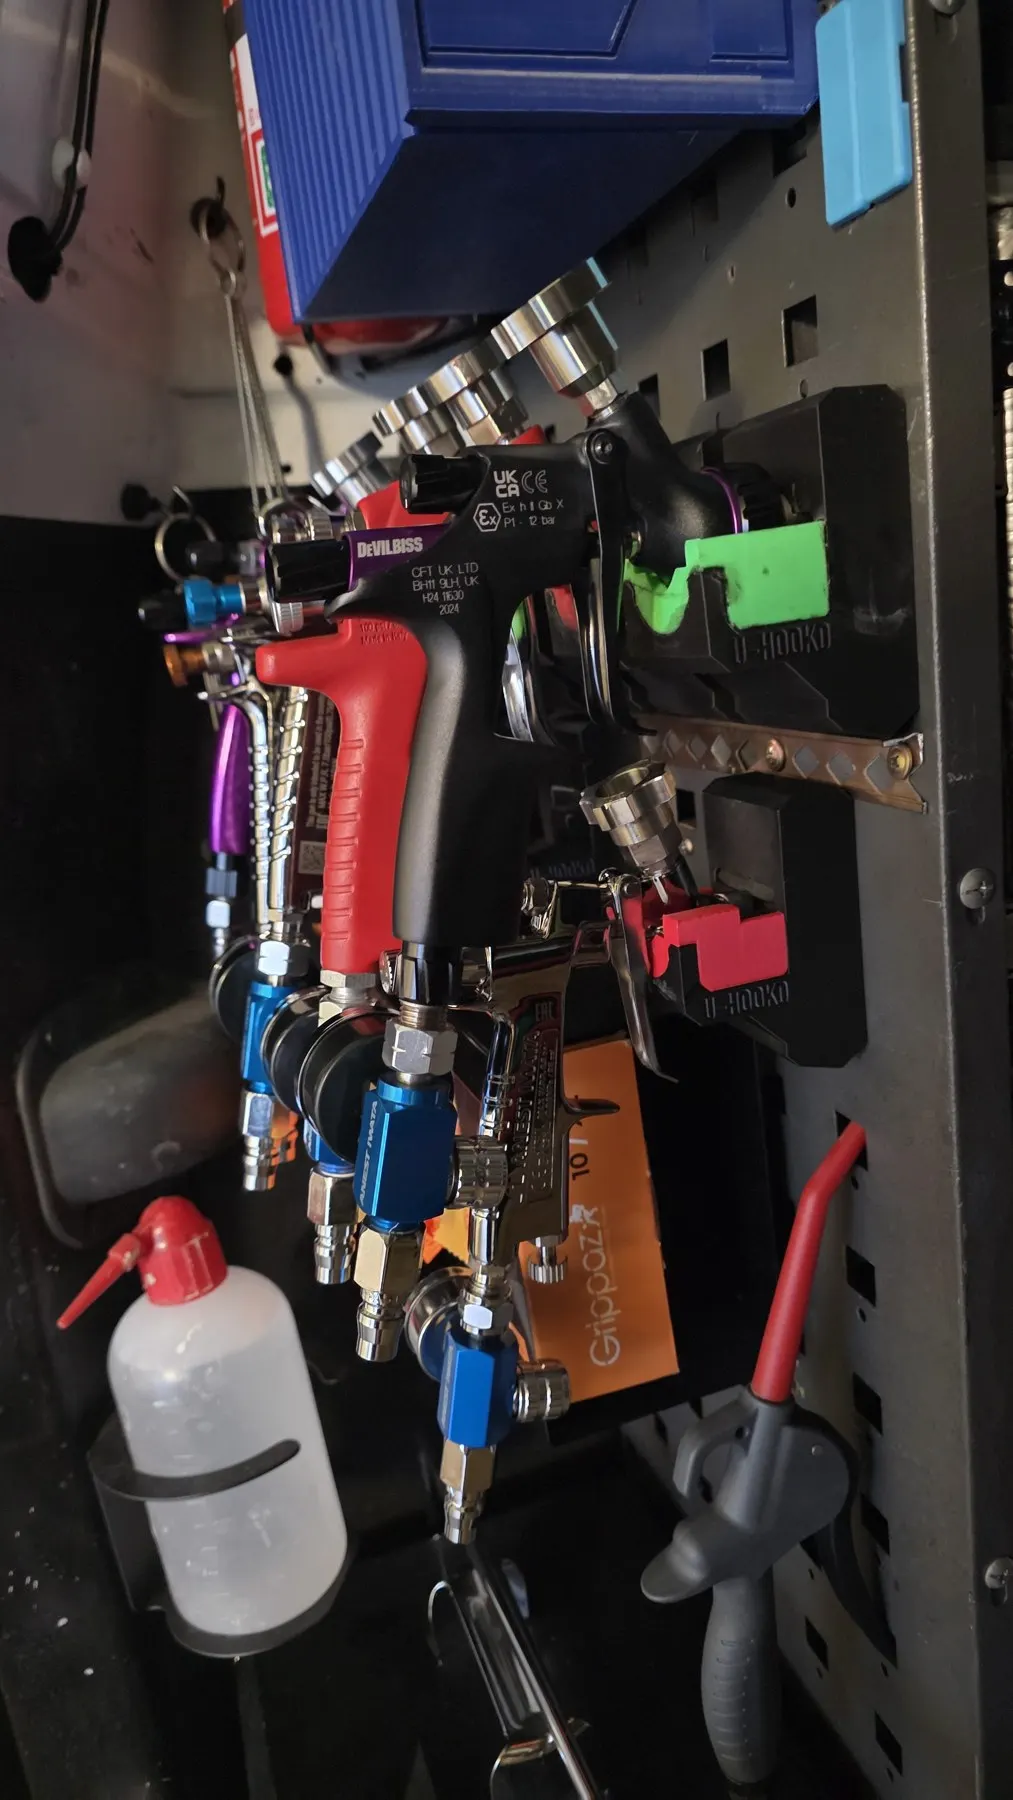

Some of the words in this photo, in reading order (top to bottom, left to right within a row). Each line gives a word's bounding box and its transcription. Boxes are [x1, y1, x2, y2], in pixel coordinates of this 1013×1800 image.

[493, 470, 518, 484] UK
[521, 470, 548, 494] CE
[495, 484, 520, 498] CA
[502, 502, 515, 513] Ex
[556, 498, 564, 511] X
[528, 515, 538, 526] 12
[541, 515, 555, 525] bar
[411, 565, 433, 578] CFT
[438, 564, 454, 576] UK
[457, 562, 479, 574] LTD
[412, 579, 436, 592] BH11
[464, 575, 480, 587] UK
[422, 591, 440, 604] H24
[439, 602, 460, 616] 2024
[359, 1149, 369, 1207] ANEST
[367, 1100, 379, 1148] IWATA
[569, 1152, 590, 1181] 10
